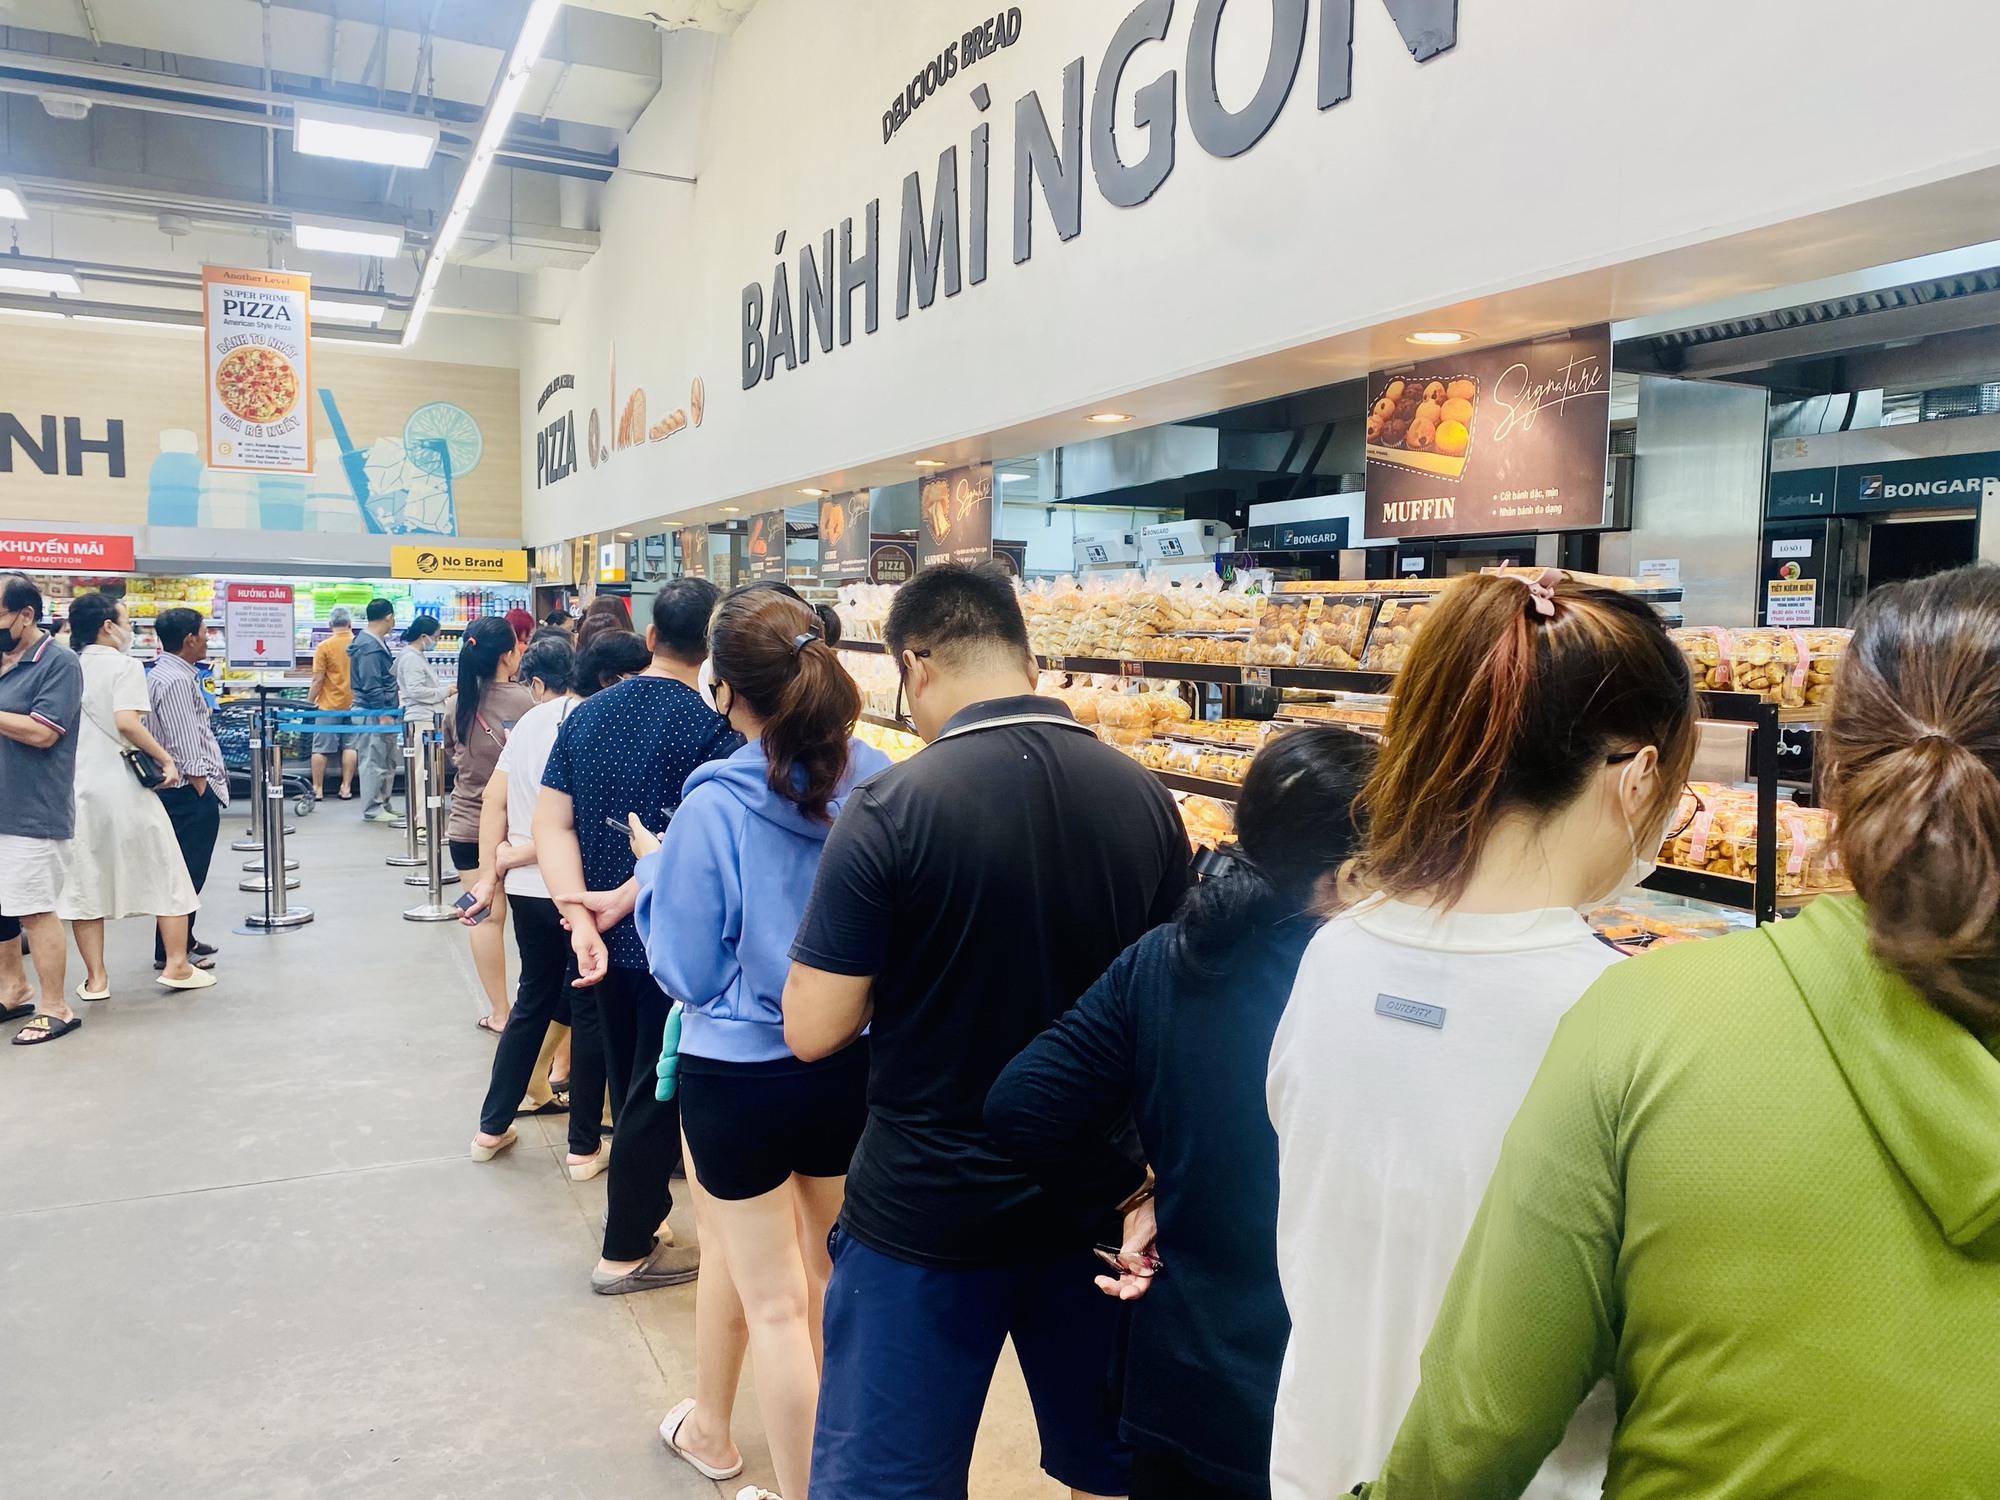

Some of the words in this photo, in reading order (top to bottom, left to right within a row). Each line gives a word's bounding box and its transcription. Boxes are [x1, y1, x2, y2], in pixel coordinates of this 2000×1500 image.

[882, 41, 958, 145] DELICIOUS
[961, 7, 1022, 70] BREAD
[742, 229, 879, 390] BÁNH
[896, 82, 990, 320] MÌ
[223, 271, 262, 281] Another
[264, 275, 290, 285] Level
[223, 289, 256, 300] SUPER
[260, 292, 291, 303] PRIME
[223, 299, 292, 321] PIZZA
[223, 319, 255, 327] American
[256, 321, 273, 329] Style
[274, 322, 292, 331] Pizza
[217, 333, 249, 354] BÁNH
[249, 332, 266, 345] TO
[267, 337, 298, 359] NHẤT
[1493, 355, 1610, 442] Signature
[220, 412, 242, 432] GIÁ
[267, 415, 301, 438] NHẤT
[0, 412, 126, 478] NH
[537, 409, 577, 490] PIZZA
[1884, 476, 2000, 498] BONGAR
[1512, 490, 1529, 500] bánh
[1810, 492, 1823, 506] 4
[1382, 497, 1456, 523] MUFFIN
[1517, 505, 1534, 515] bánh
[1534, 504, 1545, 514] đa
[1545, 503, 1563, 516] dạng
[1147, 527, 1169, 536] BONGARD
[1263, 541, 1270, 549] 4
[1293, 533, 1337, 545] BONGARD
[0, 538, 67, 555] KHUYẾN
[73, 541, 104, 555] MÃI
[19, 555, 82, 564] PROMOTION
[442, 556, 461, 567] No
[465, 557, 503, 568] Brand
[877, 560, 906, 571] PIZZA
[237, 588, 267, 598] HƯỚNG
[268, 588, 286, 599] DẪN
